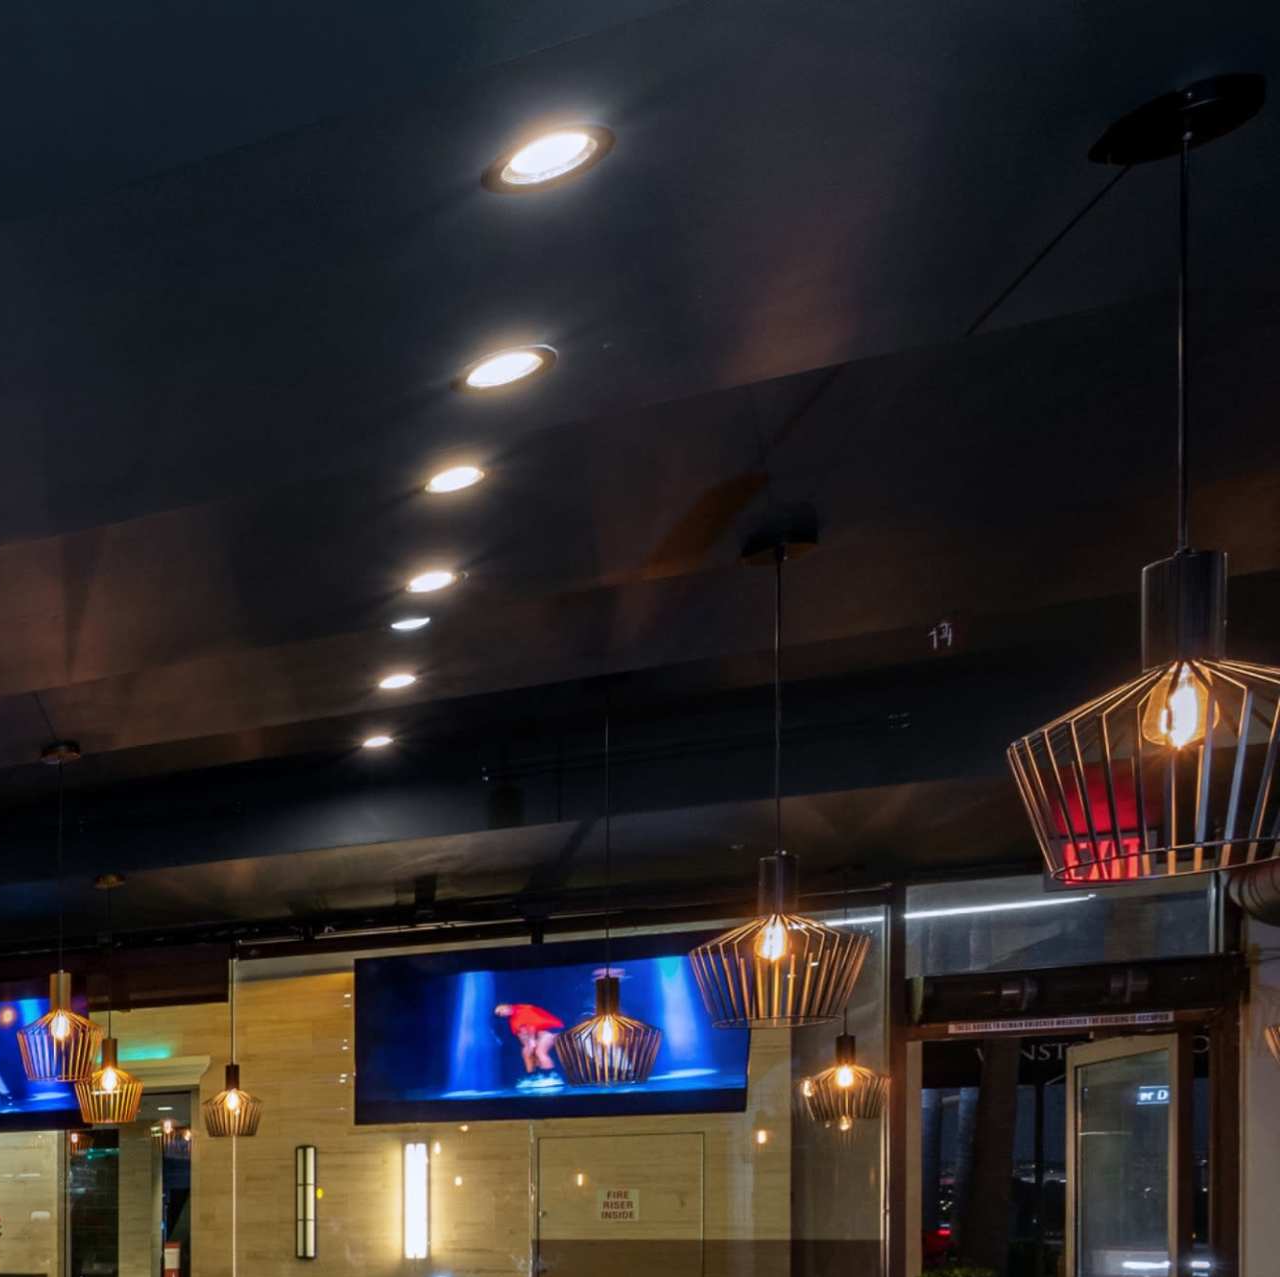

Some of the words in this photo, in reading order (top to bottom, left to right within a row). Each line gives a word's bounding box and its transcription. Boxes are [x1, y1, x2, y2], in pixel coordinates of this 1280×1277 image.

[606, 1191, 630, 1200] FIRE
[602, 1200, 634, 1210] RISER
[600, 1210, 634, 1220] INSIDE
